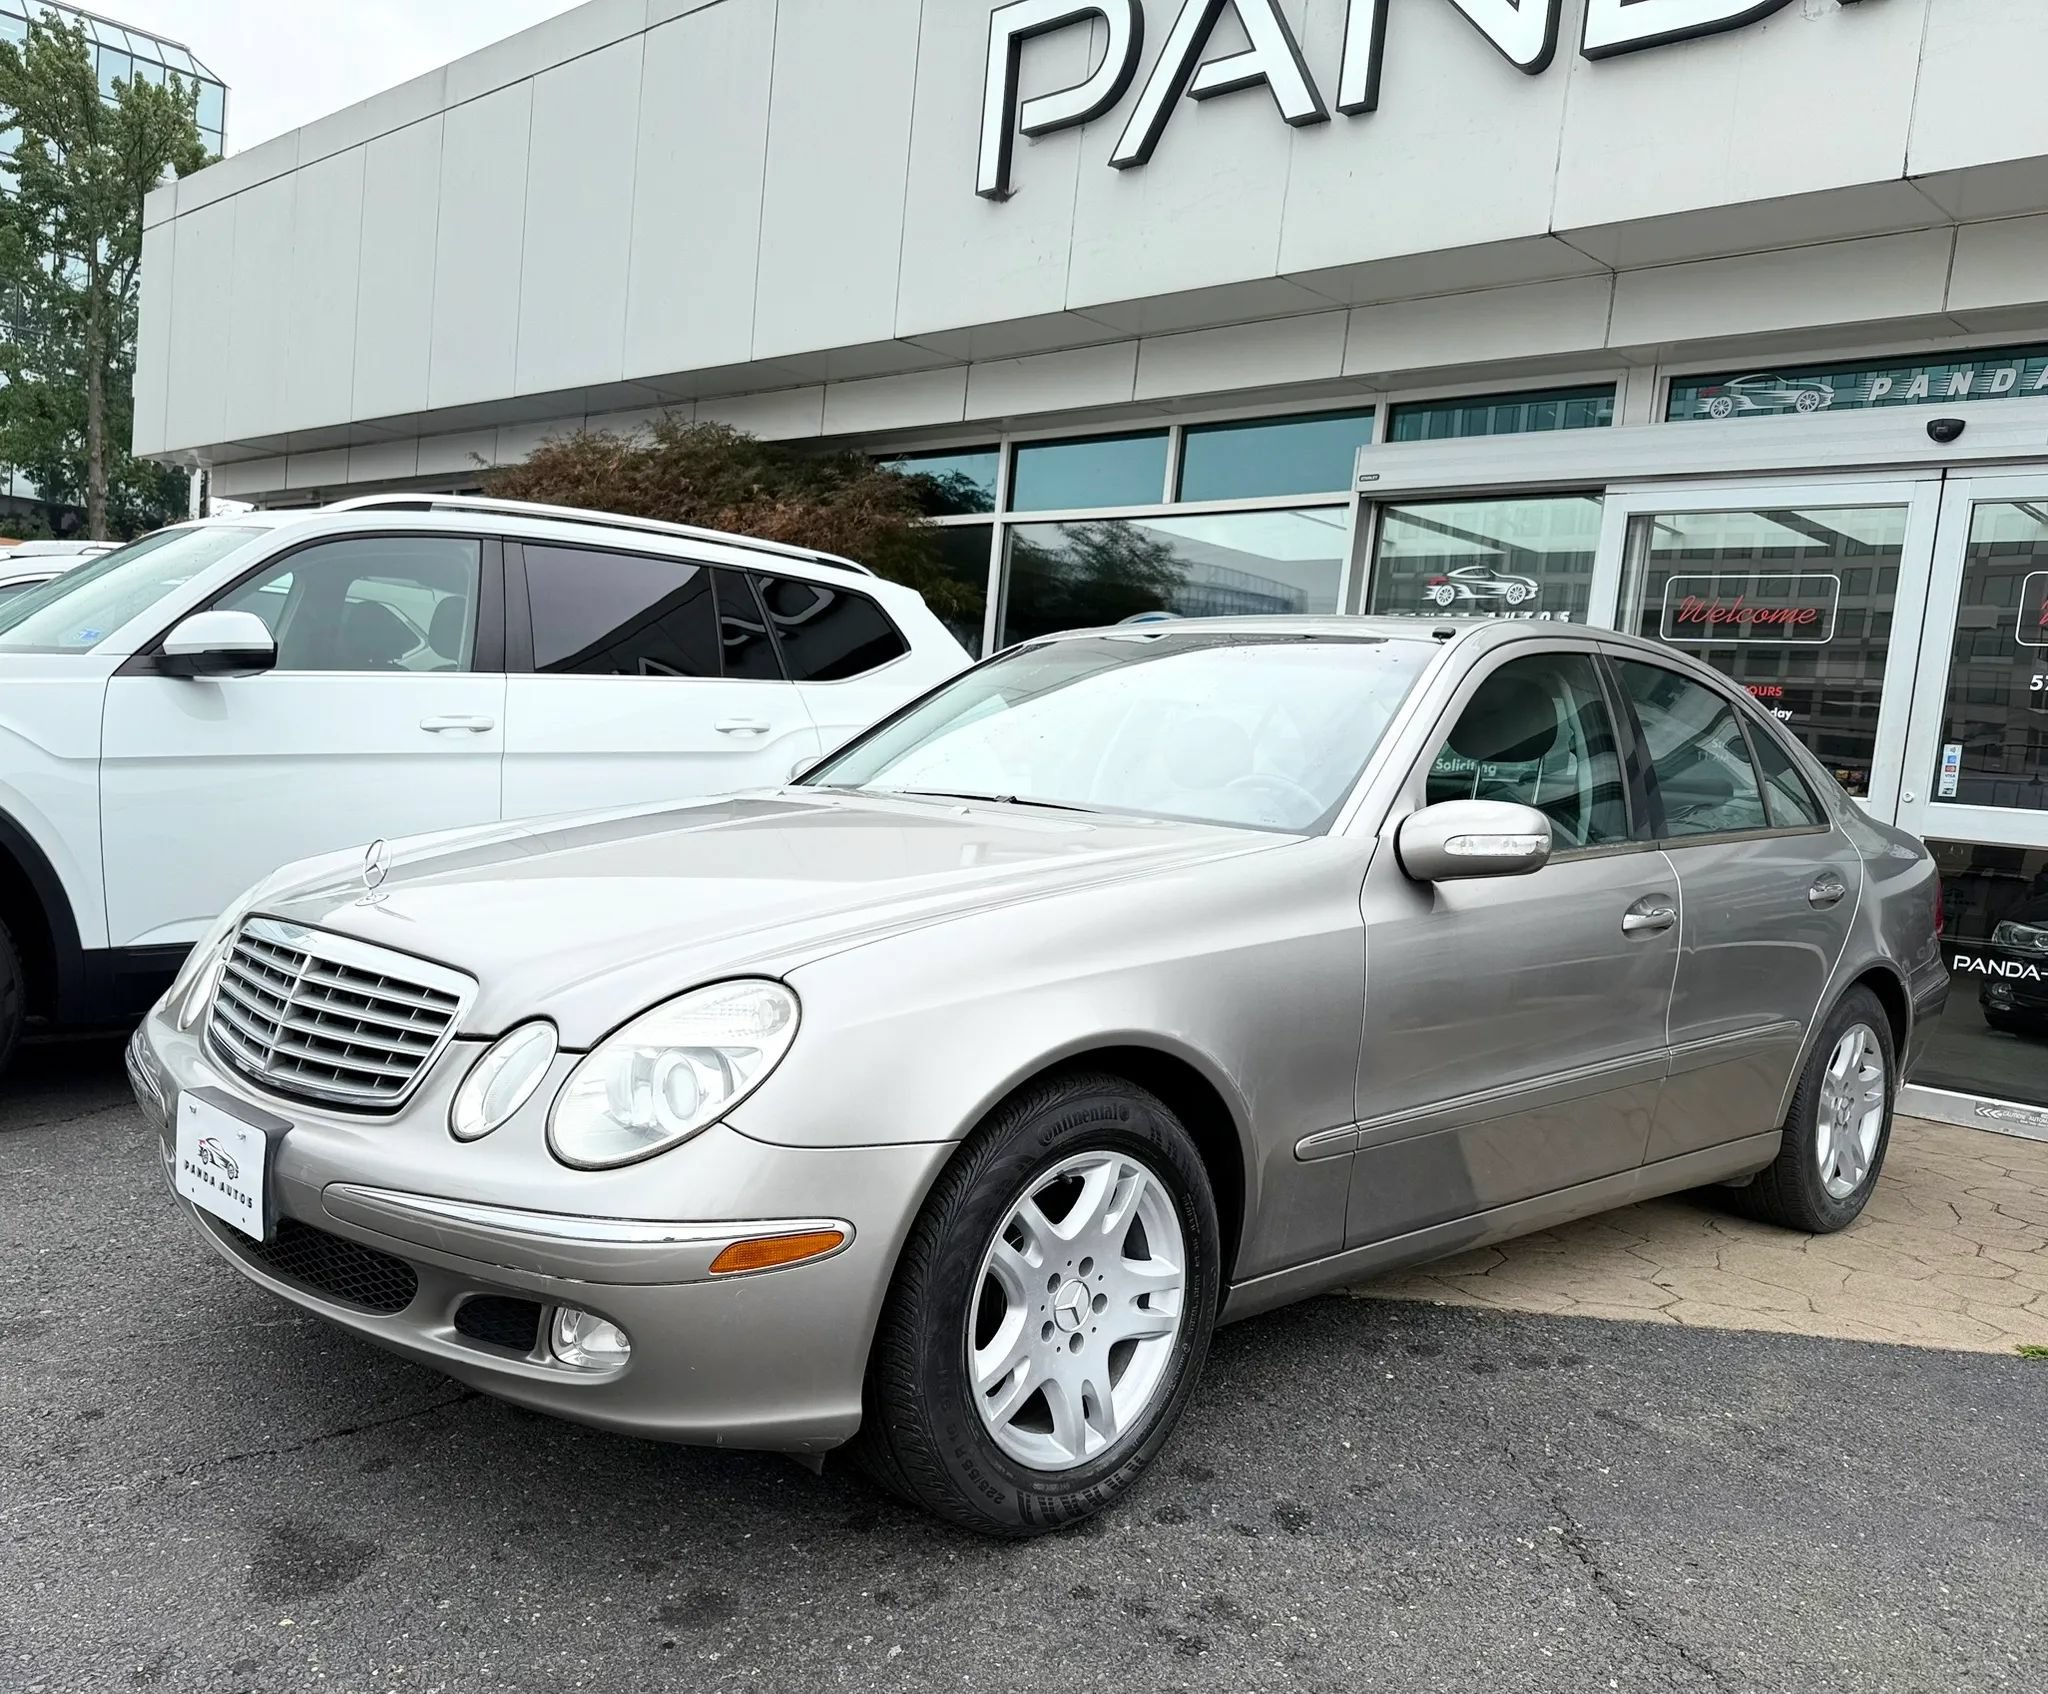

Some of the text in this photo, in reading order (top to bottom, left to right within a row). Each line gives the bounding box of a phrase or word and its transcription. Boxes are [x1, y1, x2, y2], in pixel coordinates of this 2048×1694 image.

[1678, 595, 1817, 624] Welcome
[1746, 686, 1783, 697] OURS
[1436, 758, 1496, 777] Solicitng
[184, 1160, 253, 1209] PANDA AUTOS
